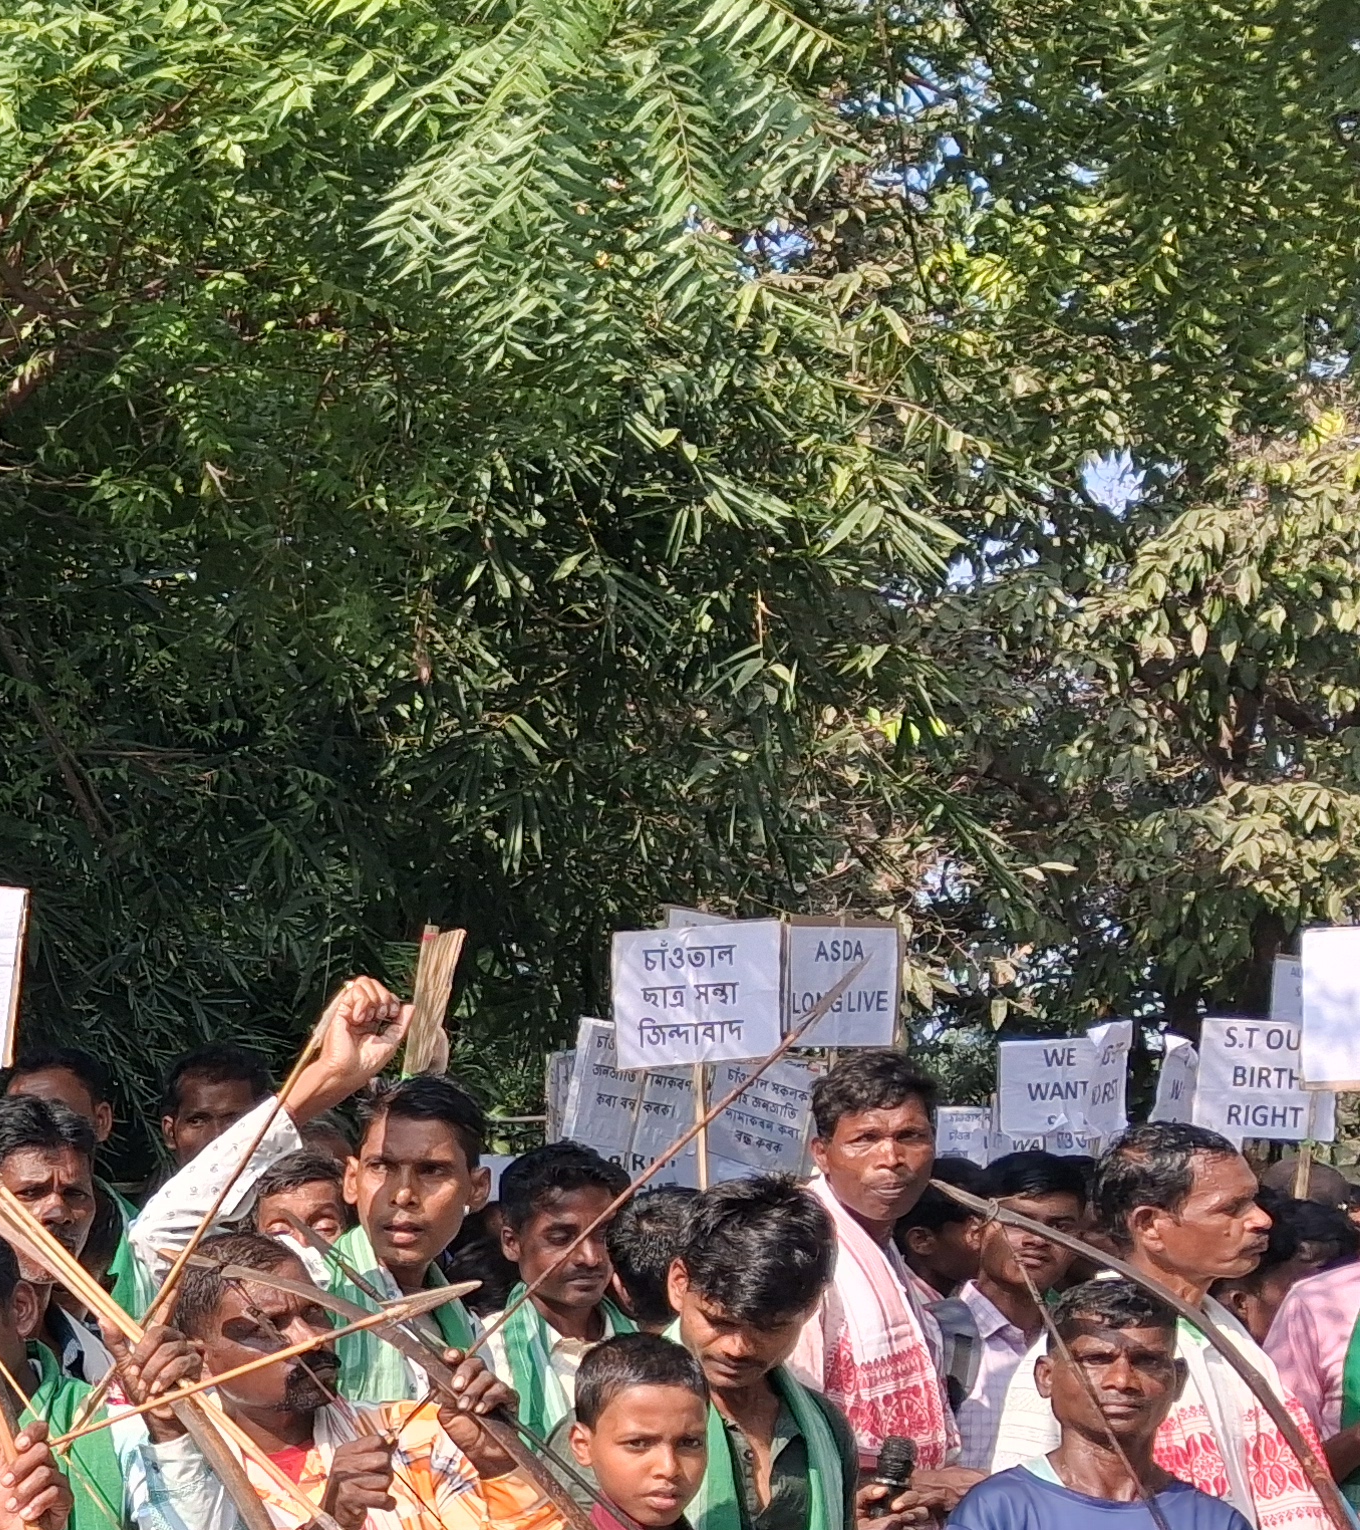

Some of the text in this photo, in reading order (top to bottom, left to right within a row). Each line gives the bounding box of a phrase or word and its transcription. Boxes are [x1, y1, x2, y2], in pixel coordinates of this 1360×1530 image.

[642, 940, 738, 972] চাঁওতাল
[814, 940, 865, 962] ASDA
[847, 990, 889, 1013] LIVE
[637, 1017, 745, 1049] জিন্দাবাদ
[1224, 1026, 1301, 1051] S.T OU
[1043, 1047, 1077, 1067] WE
[1027, 1080, 1089, 1102] WANT
[1226, 1104, 1305, 1128] RIGHT
